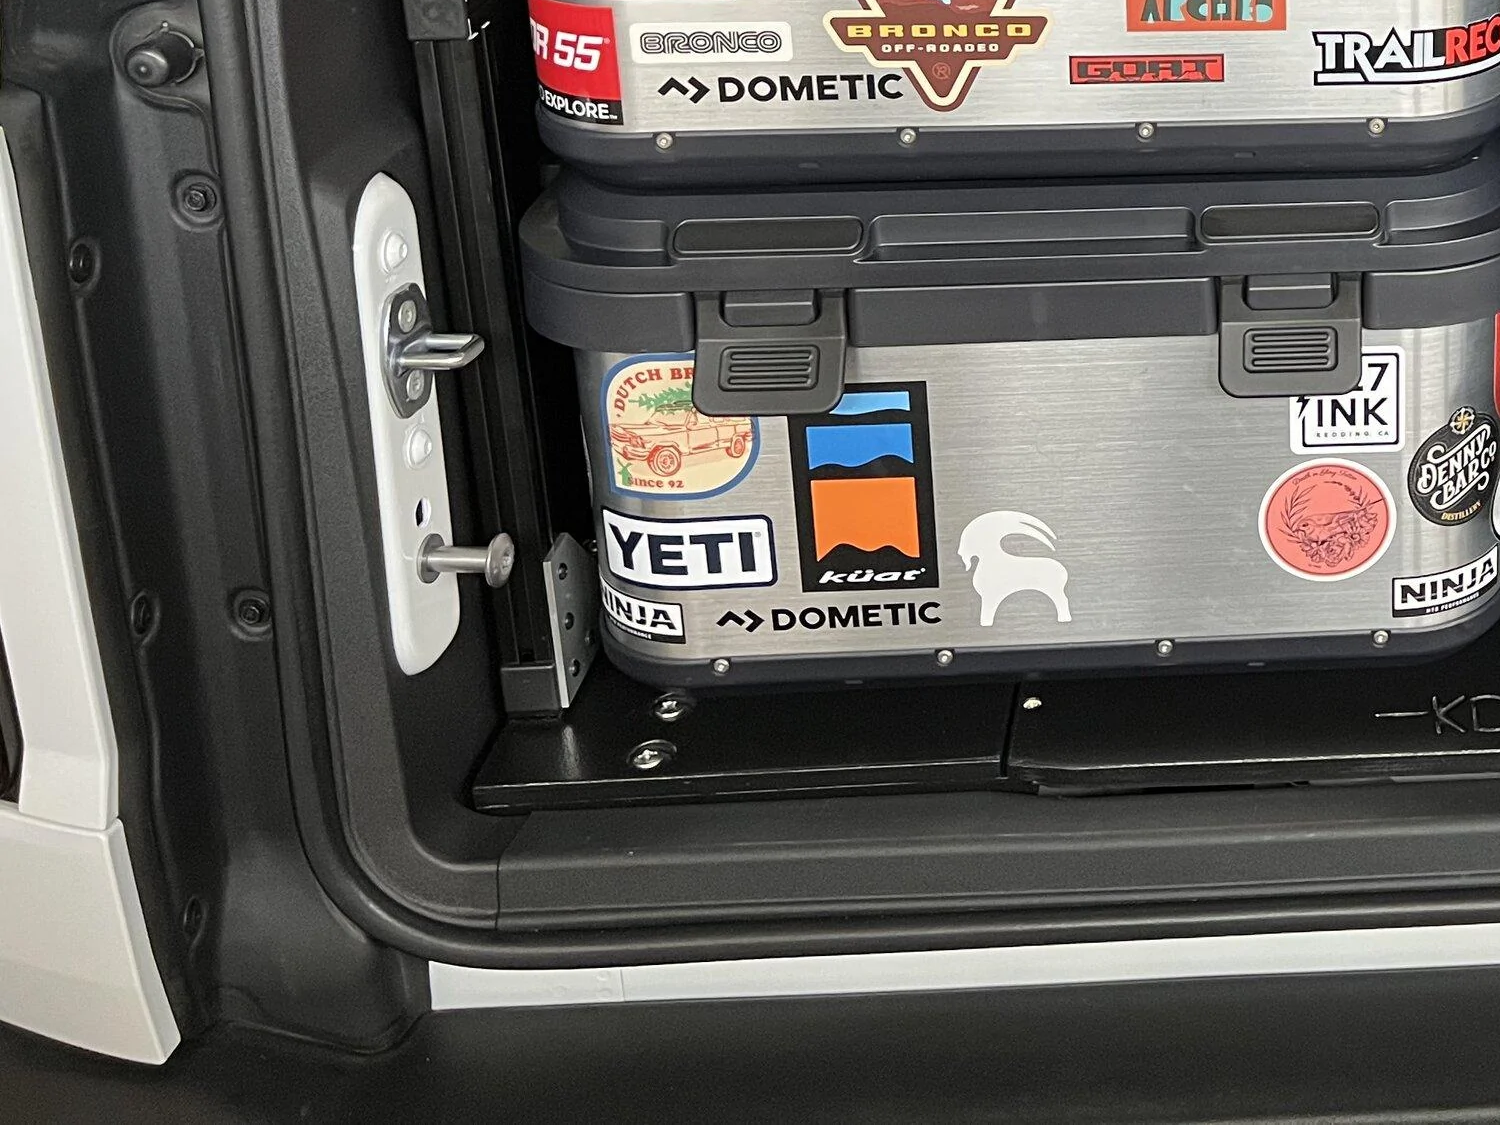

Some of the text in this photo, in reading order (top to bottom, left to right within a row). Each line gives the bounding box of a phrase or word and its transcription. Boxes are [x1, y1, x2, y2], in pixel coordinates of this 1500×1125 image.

[640, 30, 781, 54] BRONCO
[847, 24, 1031, 38] BRONCO
[553, 31, 603, 71] 55
[881, 43, 999, 53] OFF-ROADEO
[718, 74, 904, 102] DOMETIC
[545, 91, 610, 120] EXPLORE
[614, 367, 662, 412] DUTCH
[1317, 397, 1389, 427] INK
[1417, 429, 1488, 494] DENNY
[667, 480, 684, 489] 92
[1442, 458, 1479, 504] BAR
[608, 523, 757, 575] YETI
[819, 568, 921, 584] küat
[1401, 557, 1495, 604] NINJA
[771, 602, 942, 631] DOMETIC
